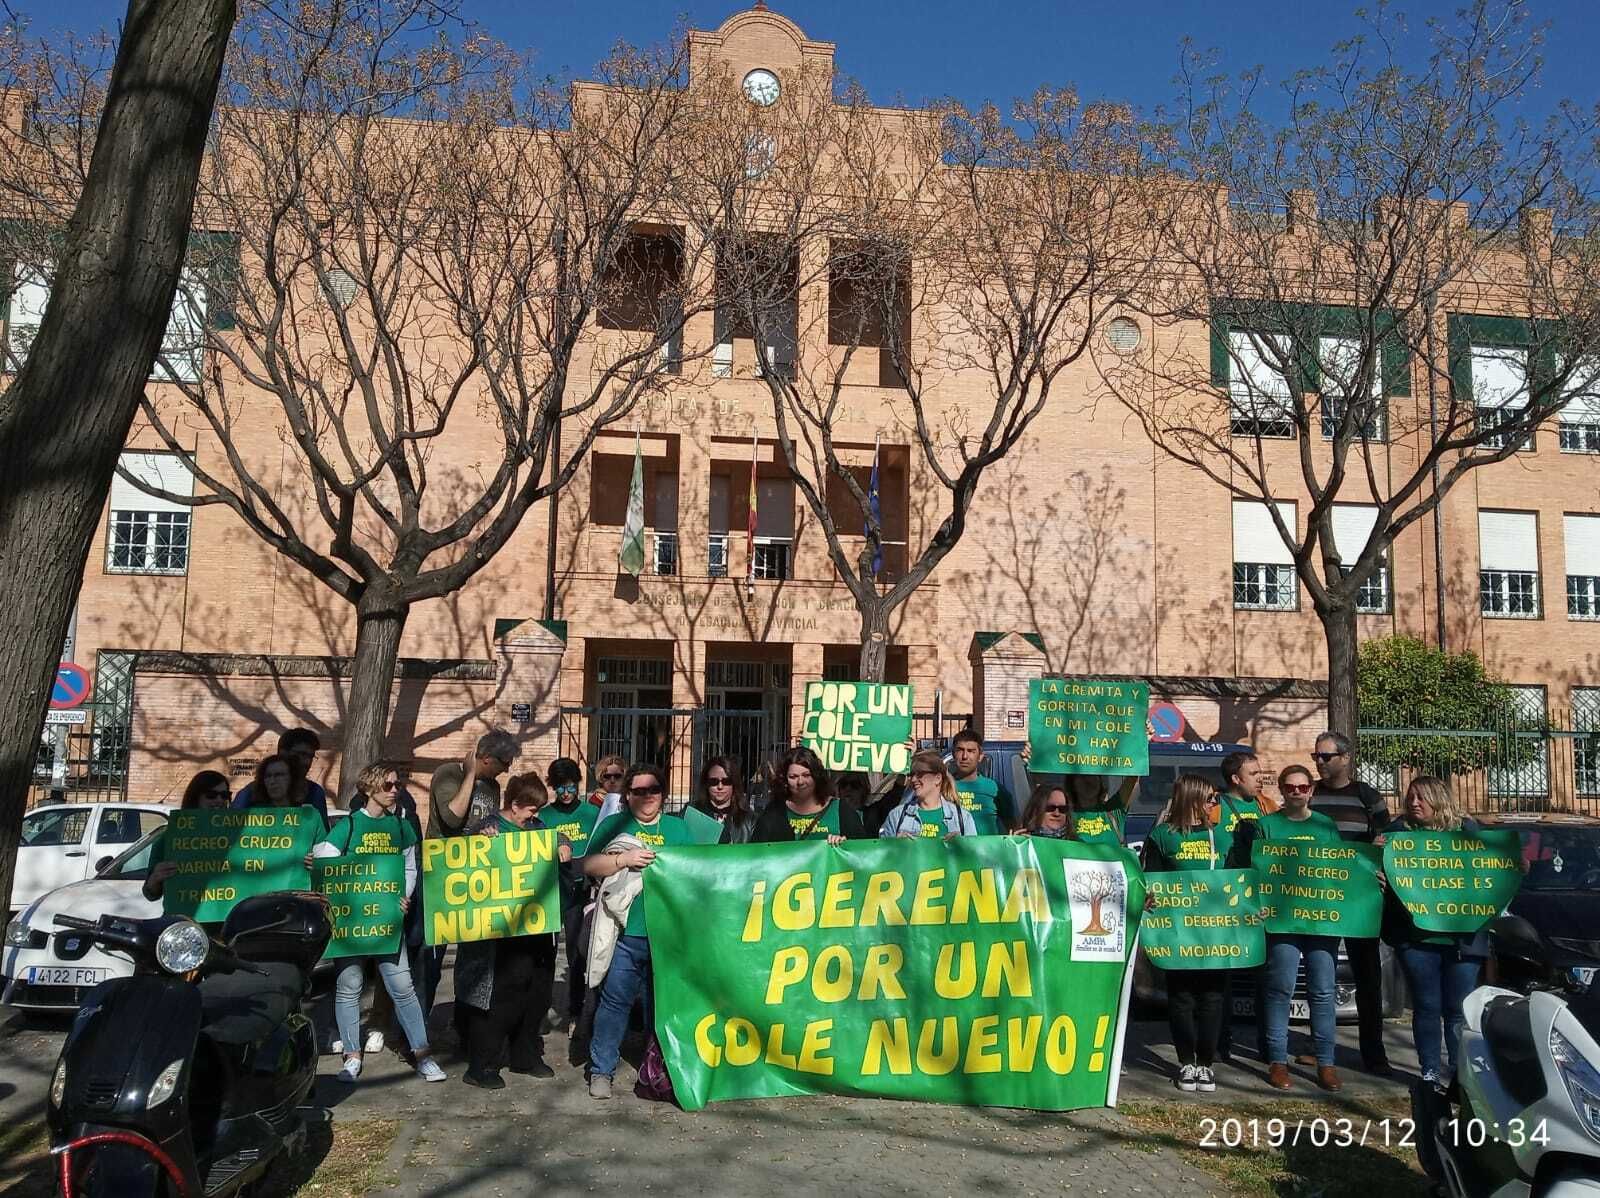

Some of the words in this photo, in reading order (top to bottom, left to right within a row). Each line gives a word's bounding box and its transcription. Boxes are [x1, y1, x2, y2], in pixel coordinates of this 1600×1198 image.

[1042, 683, 1058, 694] LA
[1063, 684, 1123, 697] CREMITA
[1132, 689, 1140, 700] Y
[808, 683, 857, 713] POR
[868, 684, 910, 717] UN
[1038, 700, 1101, 715] GORRITA,
[1105, 704, 1135, 717] QUE
[801, 711, 871, 741] COLE
[1045, 716, 1063, 728] EN
[1068, 719, 1087, 731] MI
[1095, 720, 1131, 733] COLE
[1056, 734, 1077, 746] NO
[1090, 737, 1119, 749] HAY
[1191, 743, 1224, 752] 4U-19
[809, 739, 908, 773] NUEVO
[1058, 752, 1132, 768] SOMBRITA
[176, 816, 196, 830] DE
[210, 814, 275, 827] CAMINO
[282, 814, 300, 826] AL
[240, 835, 292, 849] CRUZO
[1392, 839, 1414, 851] NO
[1426, 839, 1441, 851] ES
[1451, 839, 1486, 851] UNA
[422, 834, 491, 873] POR
[505, 829, 554, 865] UN
[1262, 845, 1299, 857] PARA
[1308, 847, 1356, 859] LLEGAR
[244, 859, 264, 872] EN
[324, 861, 377, 877] DIFÍCIL
[1393, 856, 1464, 869] HISTORIA
[1269, 863, 1287, 875] AL
[1298, 865, 1349, 881] RECREO
[444, 864, 535, 905] COLE
[1190, 882, 1209, 894] HA
[1395, 876, 1413, 888] MI
[1422, 877, 1465, 889] CLASE
[1474, 877, 1493, 889] ES
[177, 887, 236, 902] TRINEO
[1259, 883, 1273, 895] 10
[1281, 884, 1345, 901] MINUTOS
[363, 904, 380, 916] SE
[740, 868, 1051, 942] ¡GERENA
[1436, 902, 1496, 916] COCINA
[1184, 915, 1240, 928] DEBERES
[1244, 915, 1259, 926] SE
[1263, 906, 1277, 917] DE
[1293, 908, 1340, 921] PASEO
[332, 927, 348, 939] MI
[352, 925, 394, 937] CLASE
[434, 903, 546, 945] NUEVO
[38, 969, 70, 983] 4122
[75, 970, 100, 984] FCL
[765, 940, 906, 1005] POR
[934, 940, 1033, 999] UN
[694, 1013, 834, 1076] COLE
